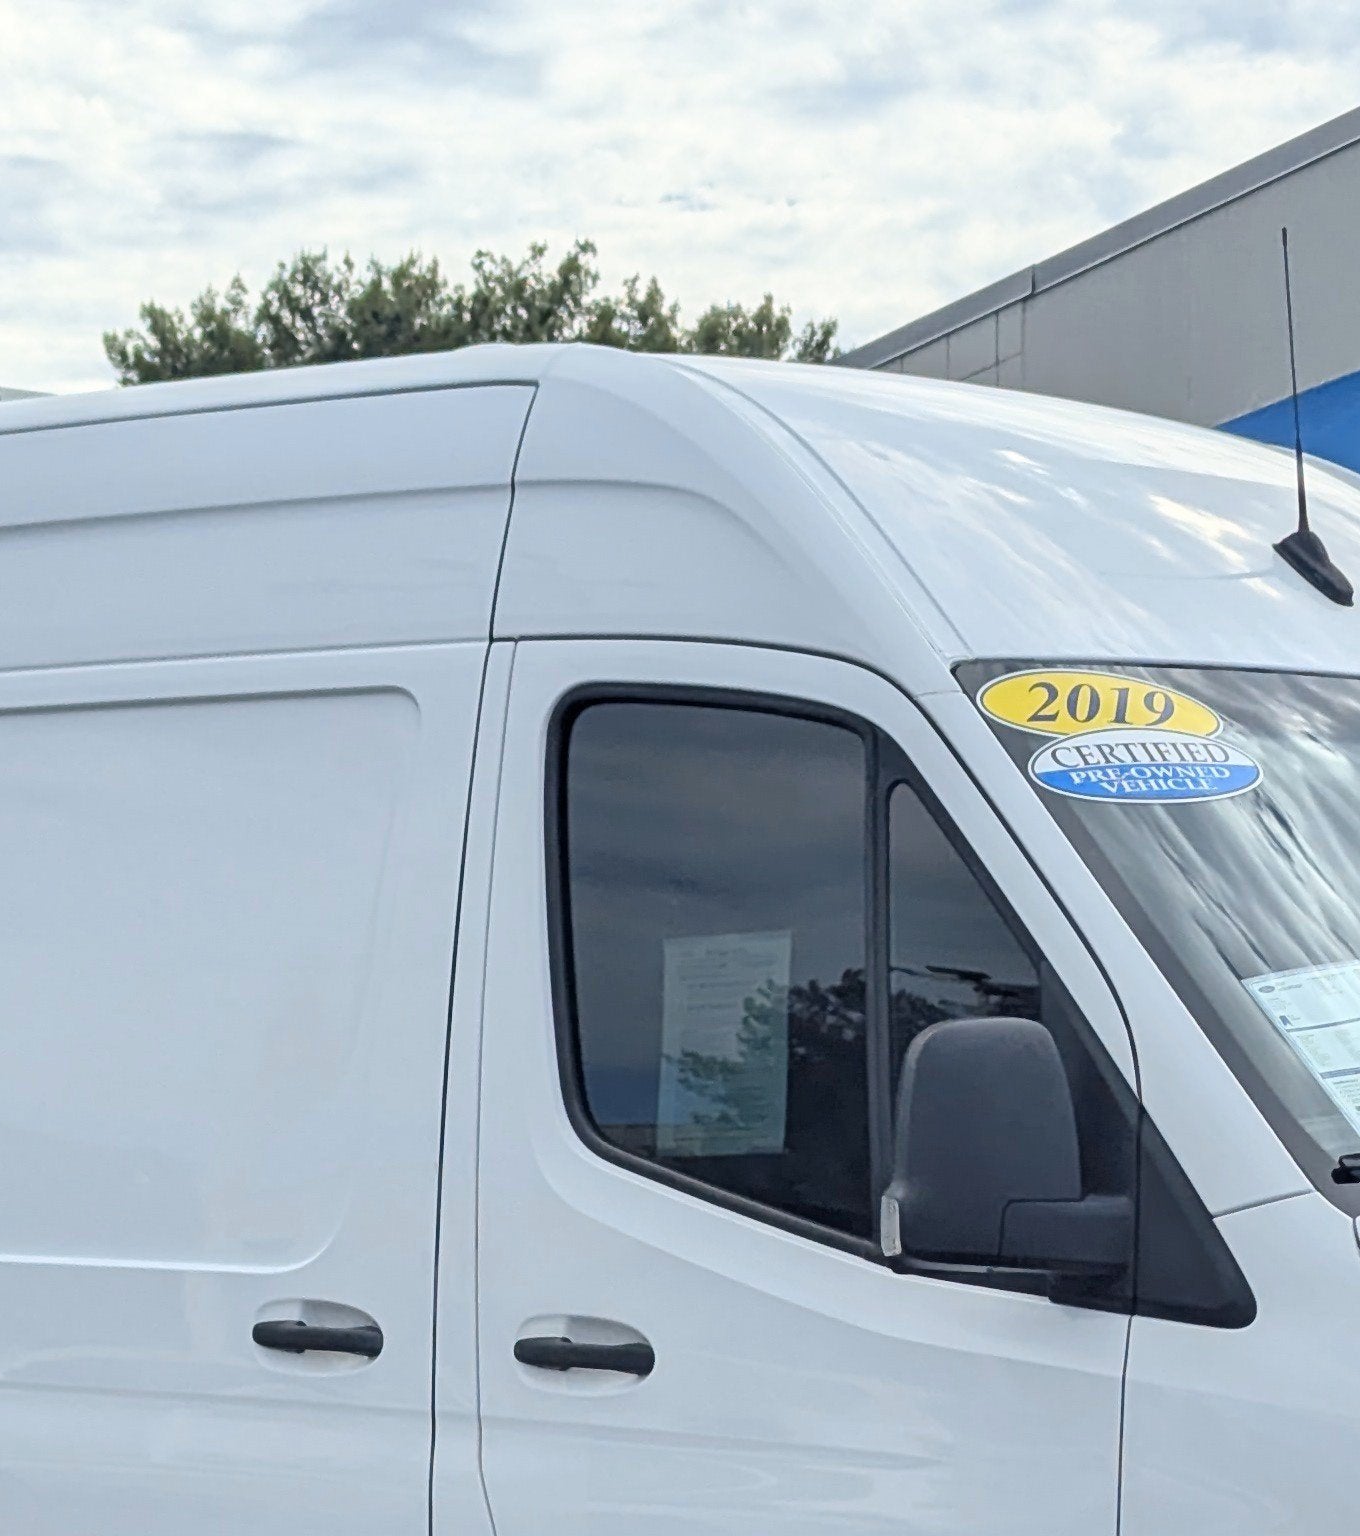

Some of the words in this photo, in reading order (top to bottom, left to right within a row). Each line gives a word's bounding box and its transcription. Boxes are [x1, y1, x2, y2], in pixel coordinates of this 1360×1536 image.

[1026, 681, 1175, 727] 2019
[1050, 741, 1230, 769] CERTIFIED
[1068, 765, 1231, 786] PRE-OWNED
[1099, 777, 1218, 793] VEHICLE
